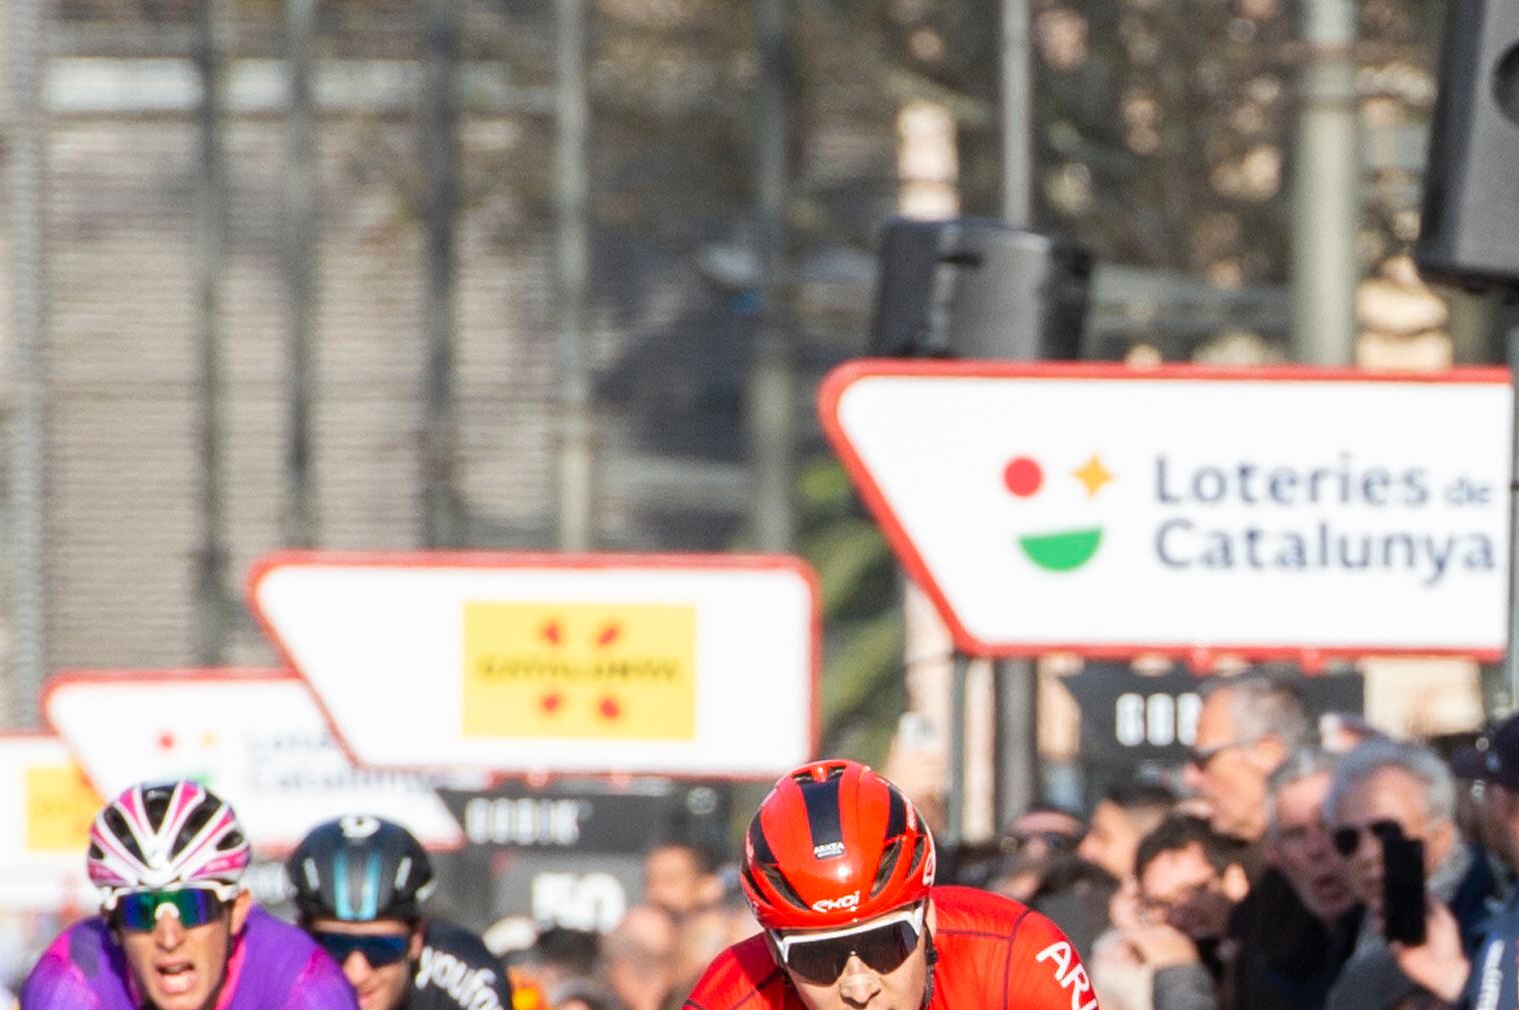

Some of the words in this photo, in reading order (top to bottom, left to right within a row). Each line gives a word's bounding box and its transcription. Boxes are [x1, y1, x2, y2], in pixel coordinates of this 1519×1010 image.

[1154, 454, 1429, 505] Loteries
[1444, 475, 1491, 506] de
[1154, 520, 1496, 586] Catalunya
